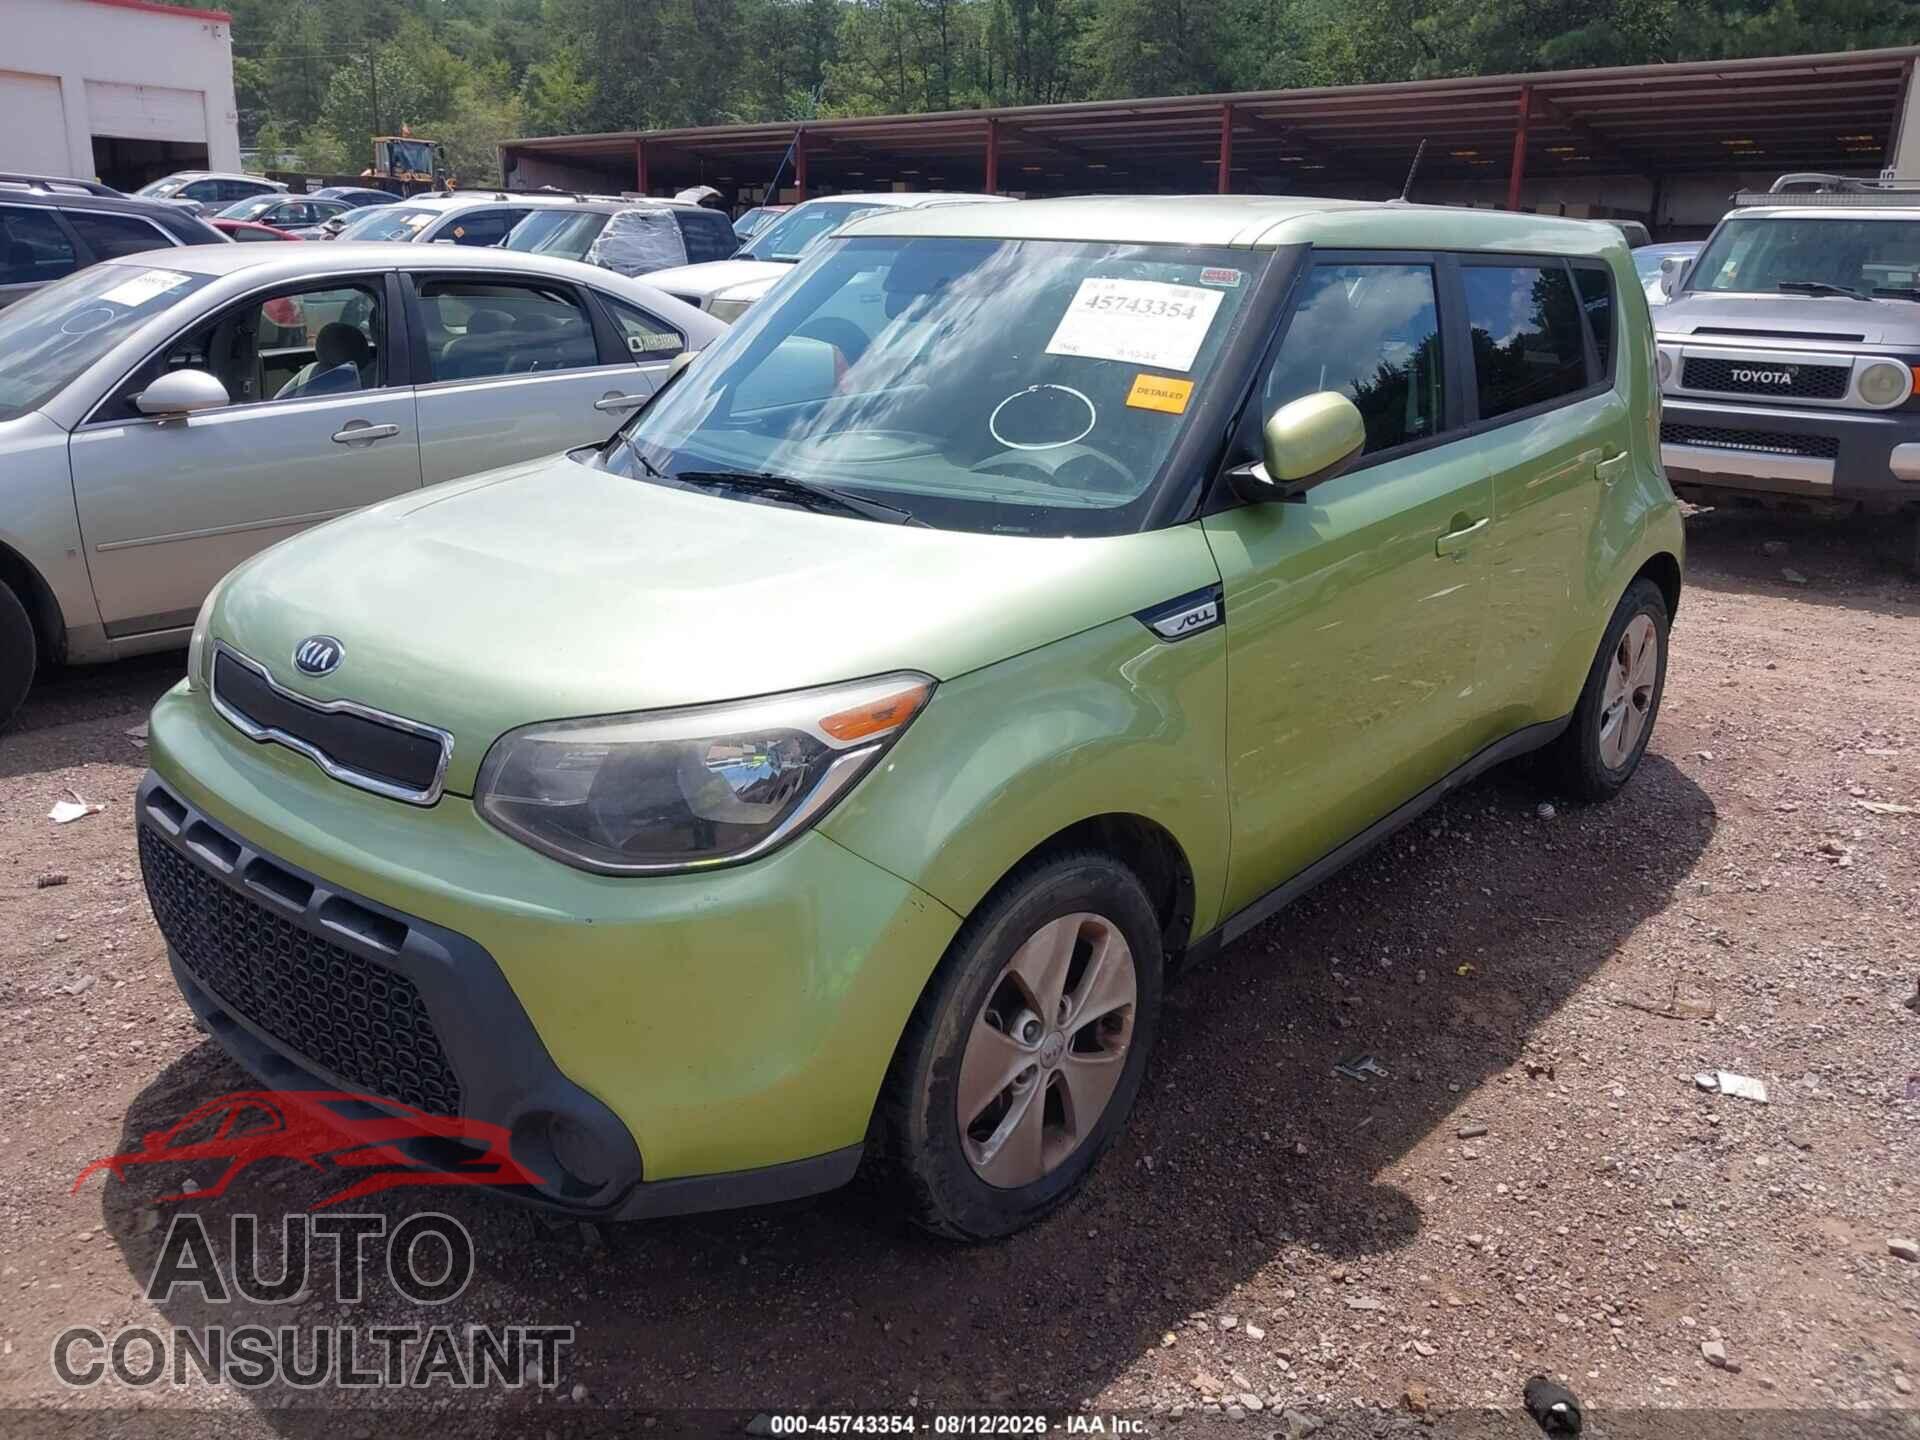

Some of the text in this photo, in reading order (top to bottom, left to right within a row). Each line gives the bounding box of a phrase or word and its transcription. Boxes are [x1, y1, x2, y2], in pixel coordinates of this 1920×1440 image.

[1085, 295, 1197, 320] 45743354
[1731, 369, 1792, 384] TOYOTA
[1136, 386, 1184, 399] DETAILED
[297, 640, 334, 669] KIA
